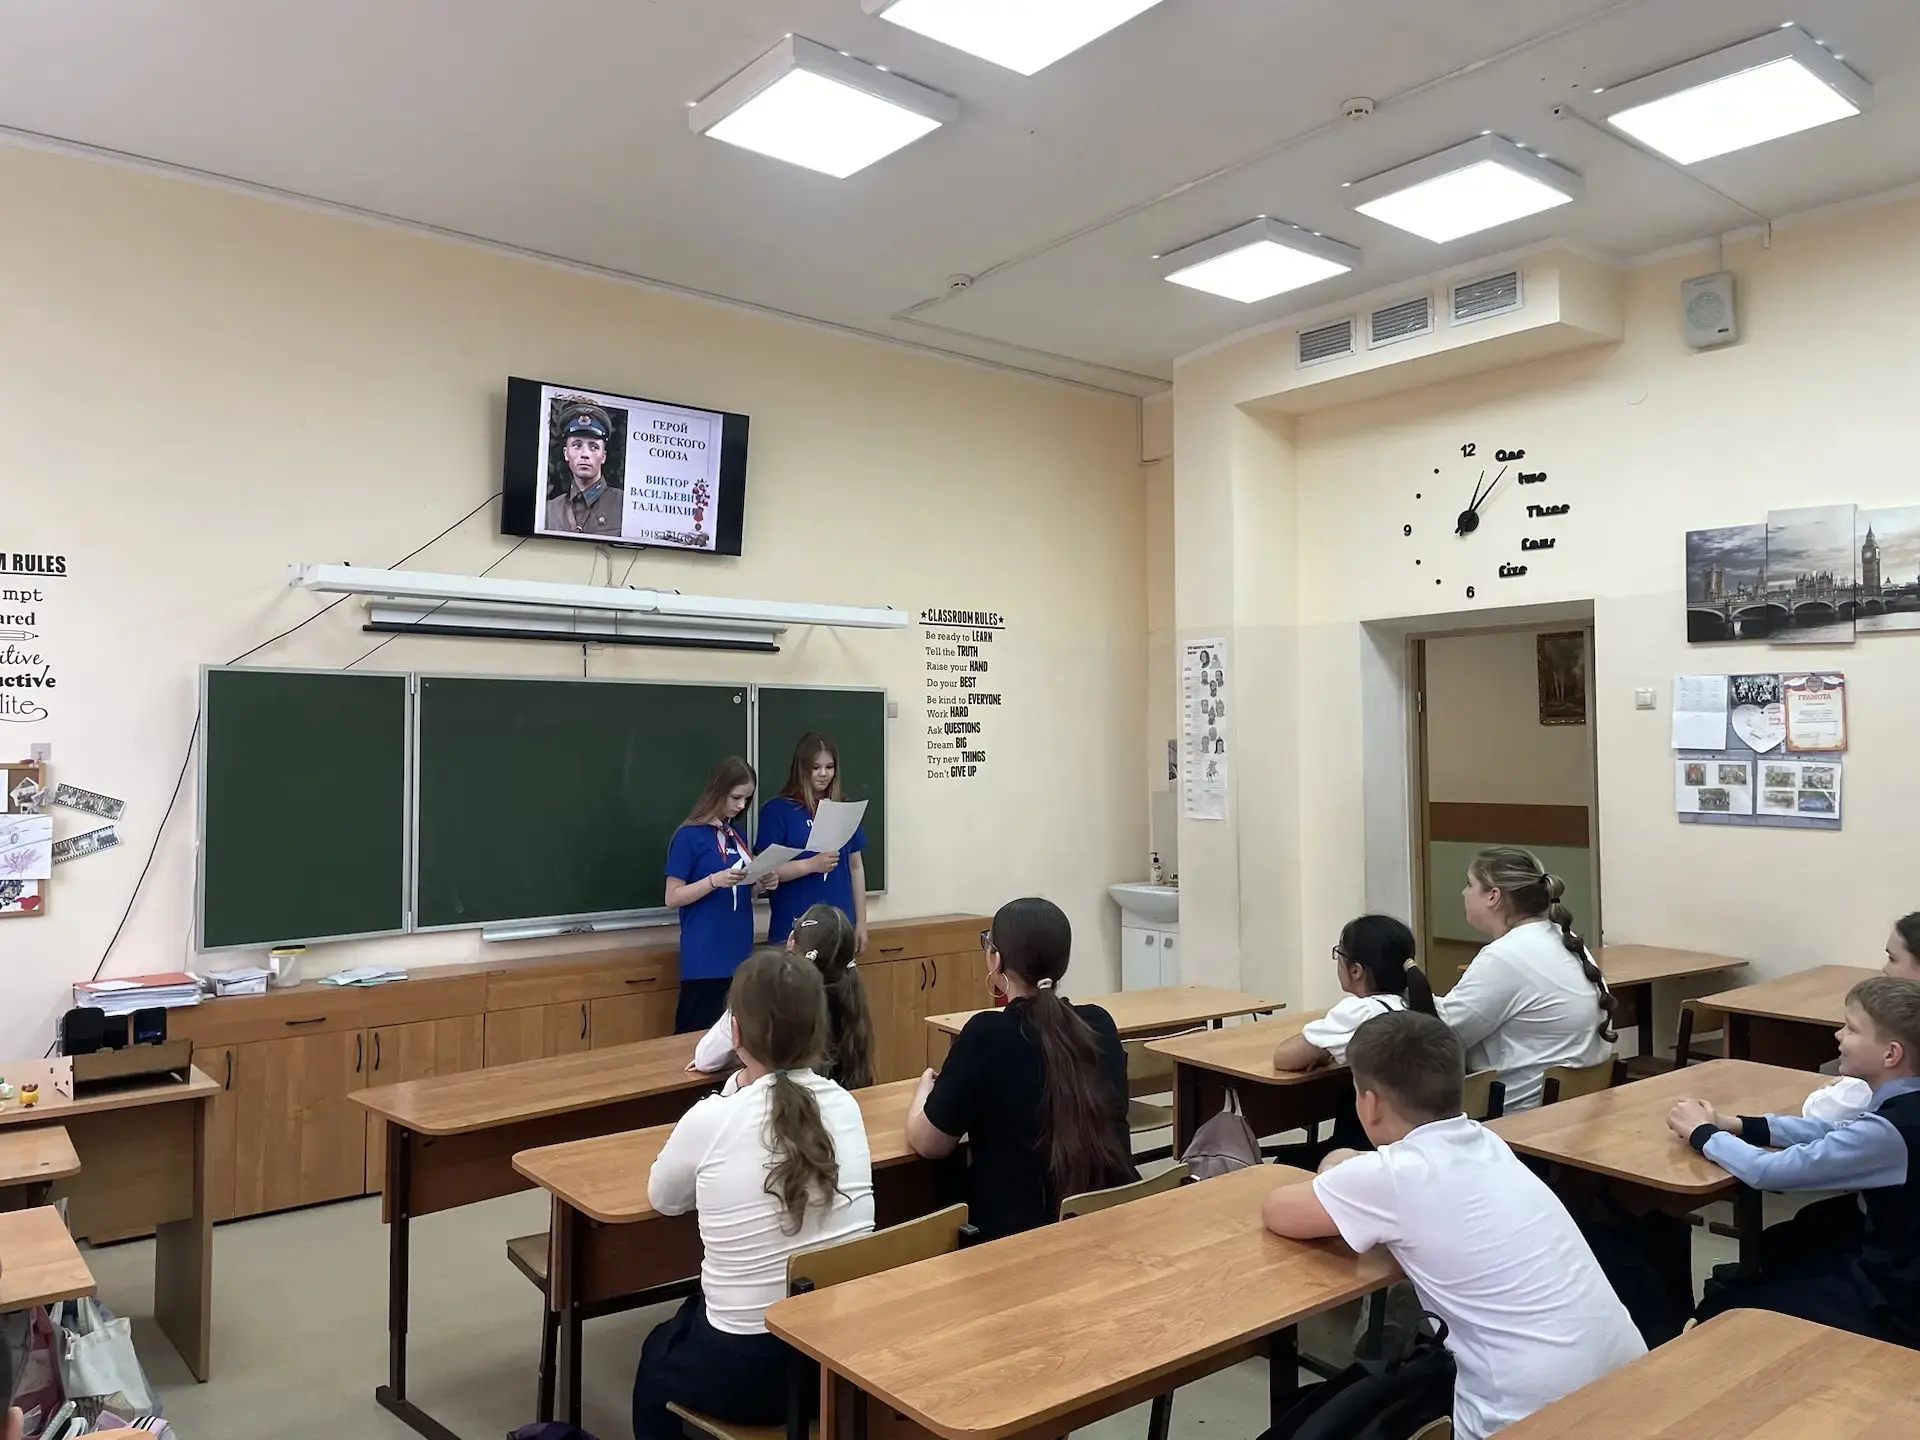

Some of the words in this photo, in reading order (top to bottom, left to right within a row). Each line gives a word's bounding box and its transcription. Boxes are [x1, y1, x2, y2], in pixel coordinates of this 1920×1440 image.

[652, 419, 688, 434] ГЕРОЙ
[633, 431, 706, 451] СОВЕТСКОГО
[649, 447, 689, 462] СОЮЗА
[1460, 443, 1476, 457] 12
[646, 474, 690, 488] ВИКТОР
[630, 486, 702, 504] ВАСИЛЬЕВИ
[1526, 503, 1571, 518] Three
[1403, 524, 1412, 536] 9
[13, 554, 66, 573] RULES
[1466, 585, 1475, 598] 6
[928, 608, 974, 624] CLASSROOM
[974, 611, 998, 626] RULES
[926, 631, 936, 640] Be
[937, 632, 961, 643] ready
[962, 633, 970, 641] to
[972, 630, 993, 642] LEARN
[926, 646, 941, 656] Tell
[942, 647, 955, 656] the
[957, 645, 978, 657] TRUTH
[926, 662, 948, 671] Raise
[950, 664, 968, 673] your
[969, 661, 988, 672] HAND
[926, 678, 938, 688] Do
[940, 680, 958, 689] your
[960, 676, 976, 688] BEST
[926, 696, 937, 704] Be
[939, 695, 957, 704] kind
[958, 696, 966, 704] to
[968, 694, 1001, 705] EVERYONE
[1797, 693, 1832, 701] ГРАМОТА
[927, 710, 948, 719] Work
[950, 706, 968, 718] HARD
[927, 726, 942, 735] Ask
[944, 722, 981, 734] QUESTIONS
[927, 741, 954, 749] Dream
[956, 737, 967, 748] BIG
[927, 756, 941, 766] Try
[943, 756, 959, 764] new
[961, 751, 986, 762] THINGS
[927, 770, 949, 778] Don't
[950, 766, 966, 778] GIVE
[968, 766, 977, 777] UP
